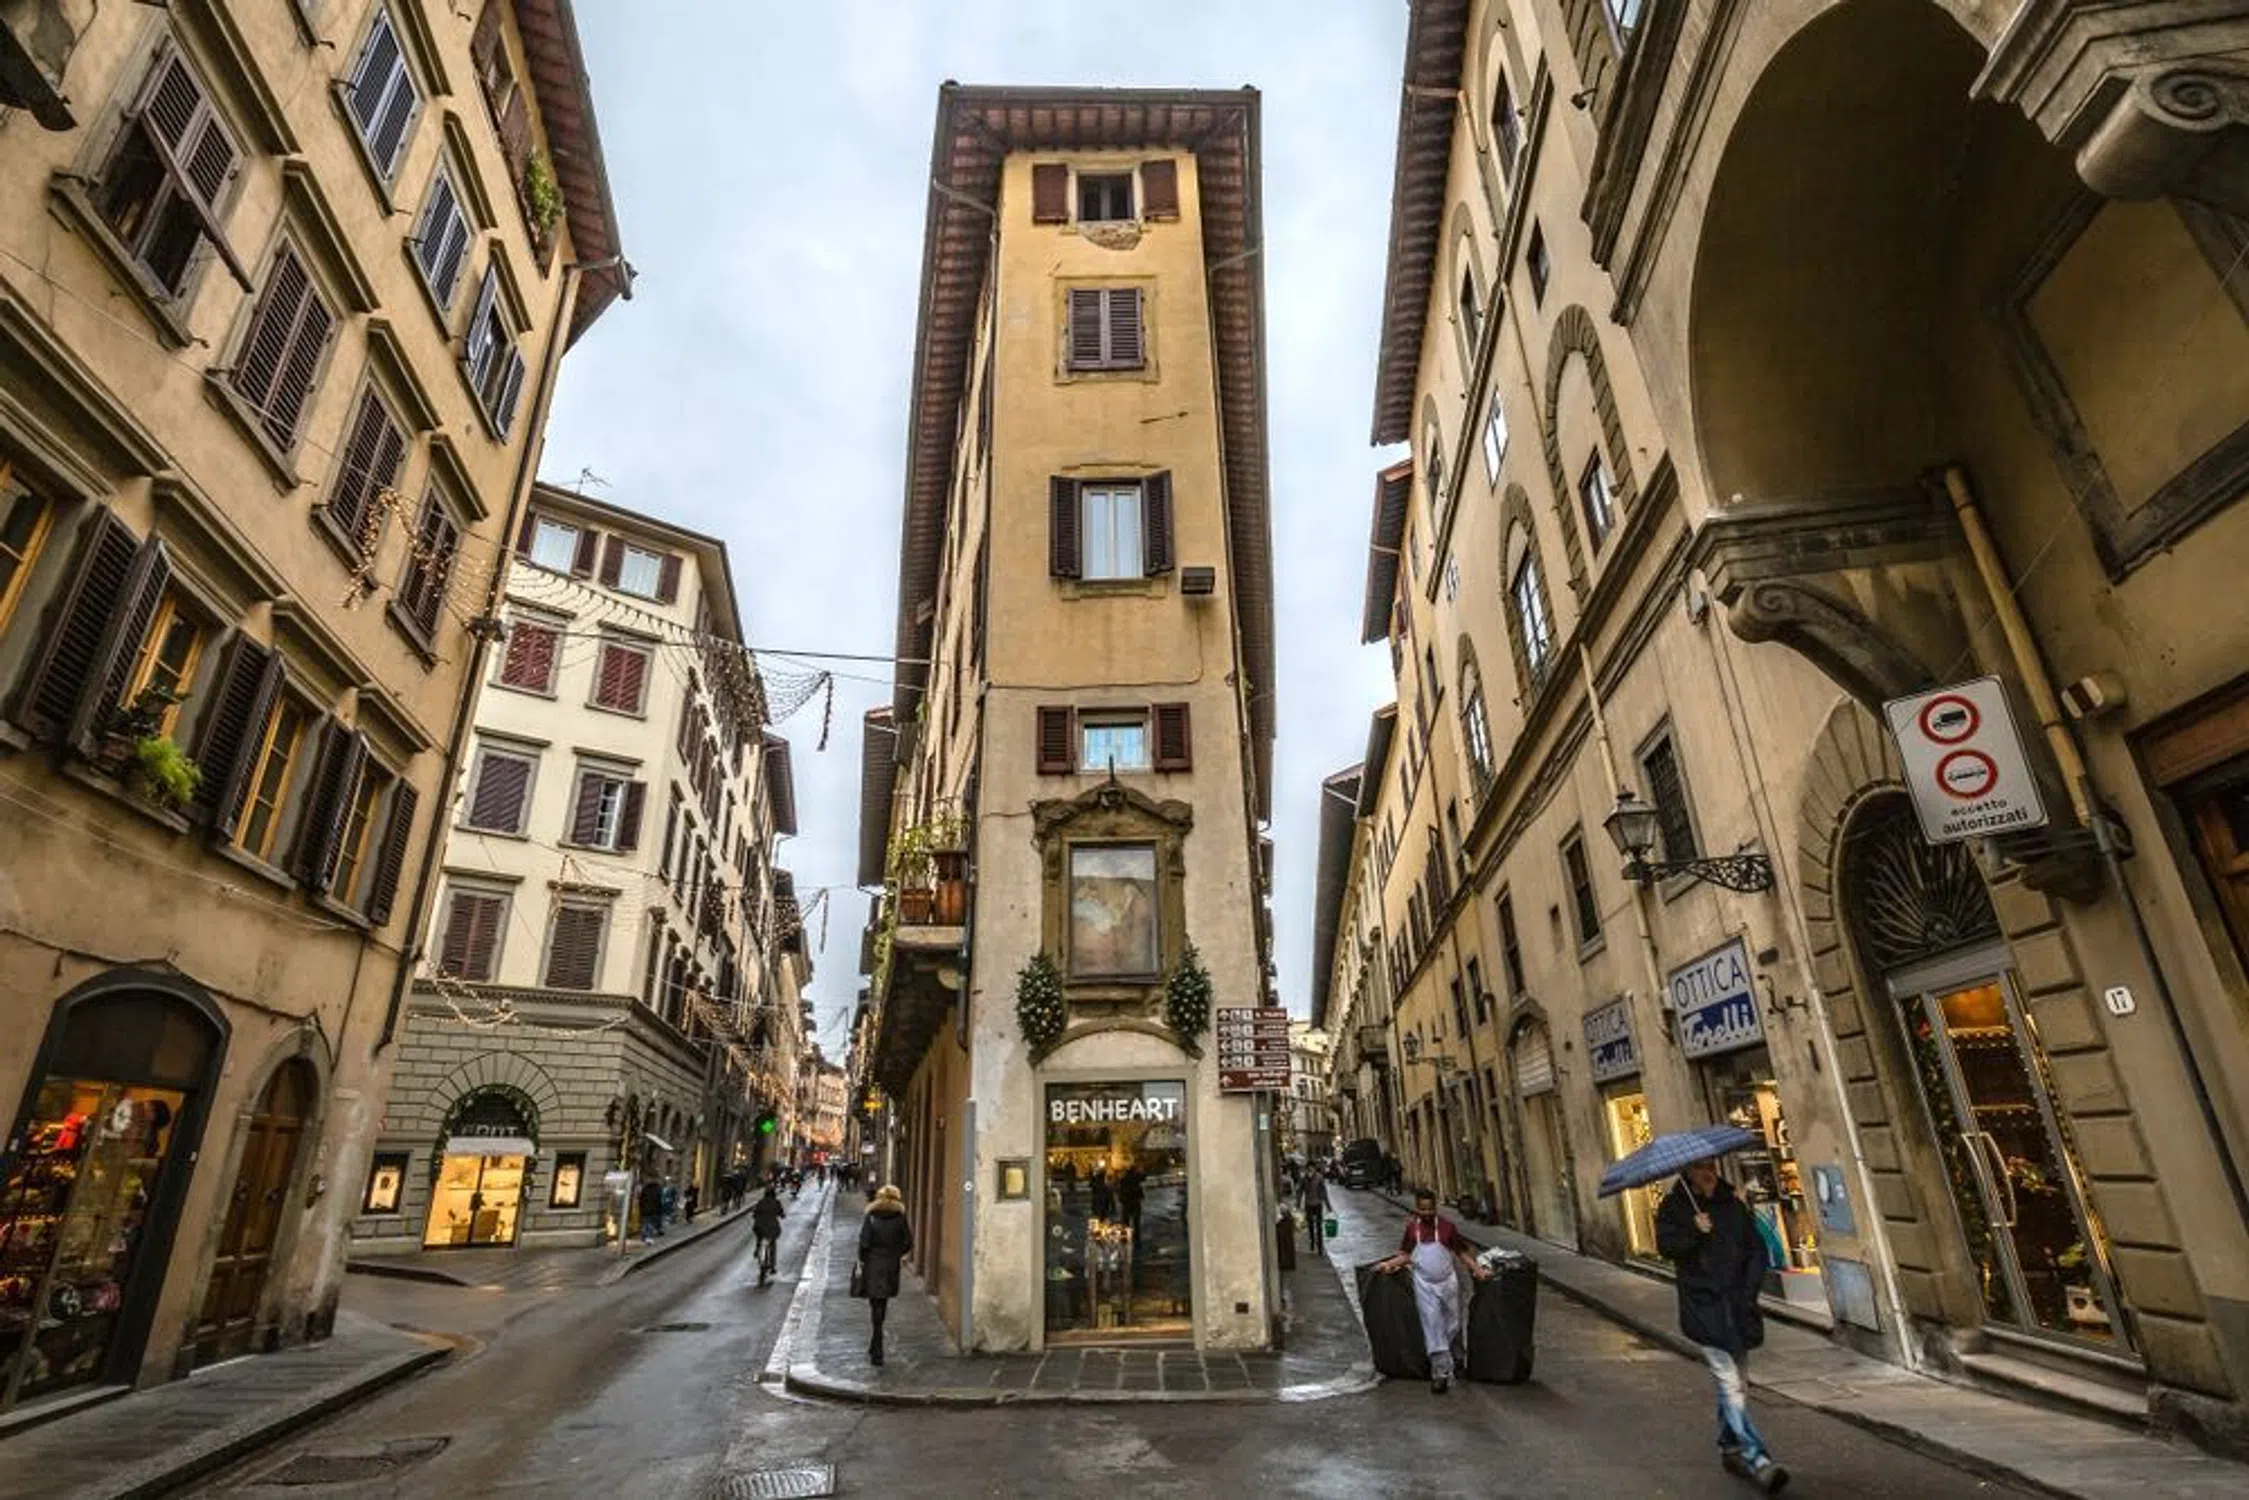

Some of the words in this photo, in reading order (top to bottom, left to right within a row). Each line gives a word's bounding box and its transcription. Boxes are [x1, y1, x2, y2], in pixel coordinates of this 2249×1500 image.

[1942, 806, 2029, 834] autorizzati
[1675, 954, 1747, 1009] OTTICA
[1050, 1097, 1178, 1121] BENHEART
